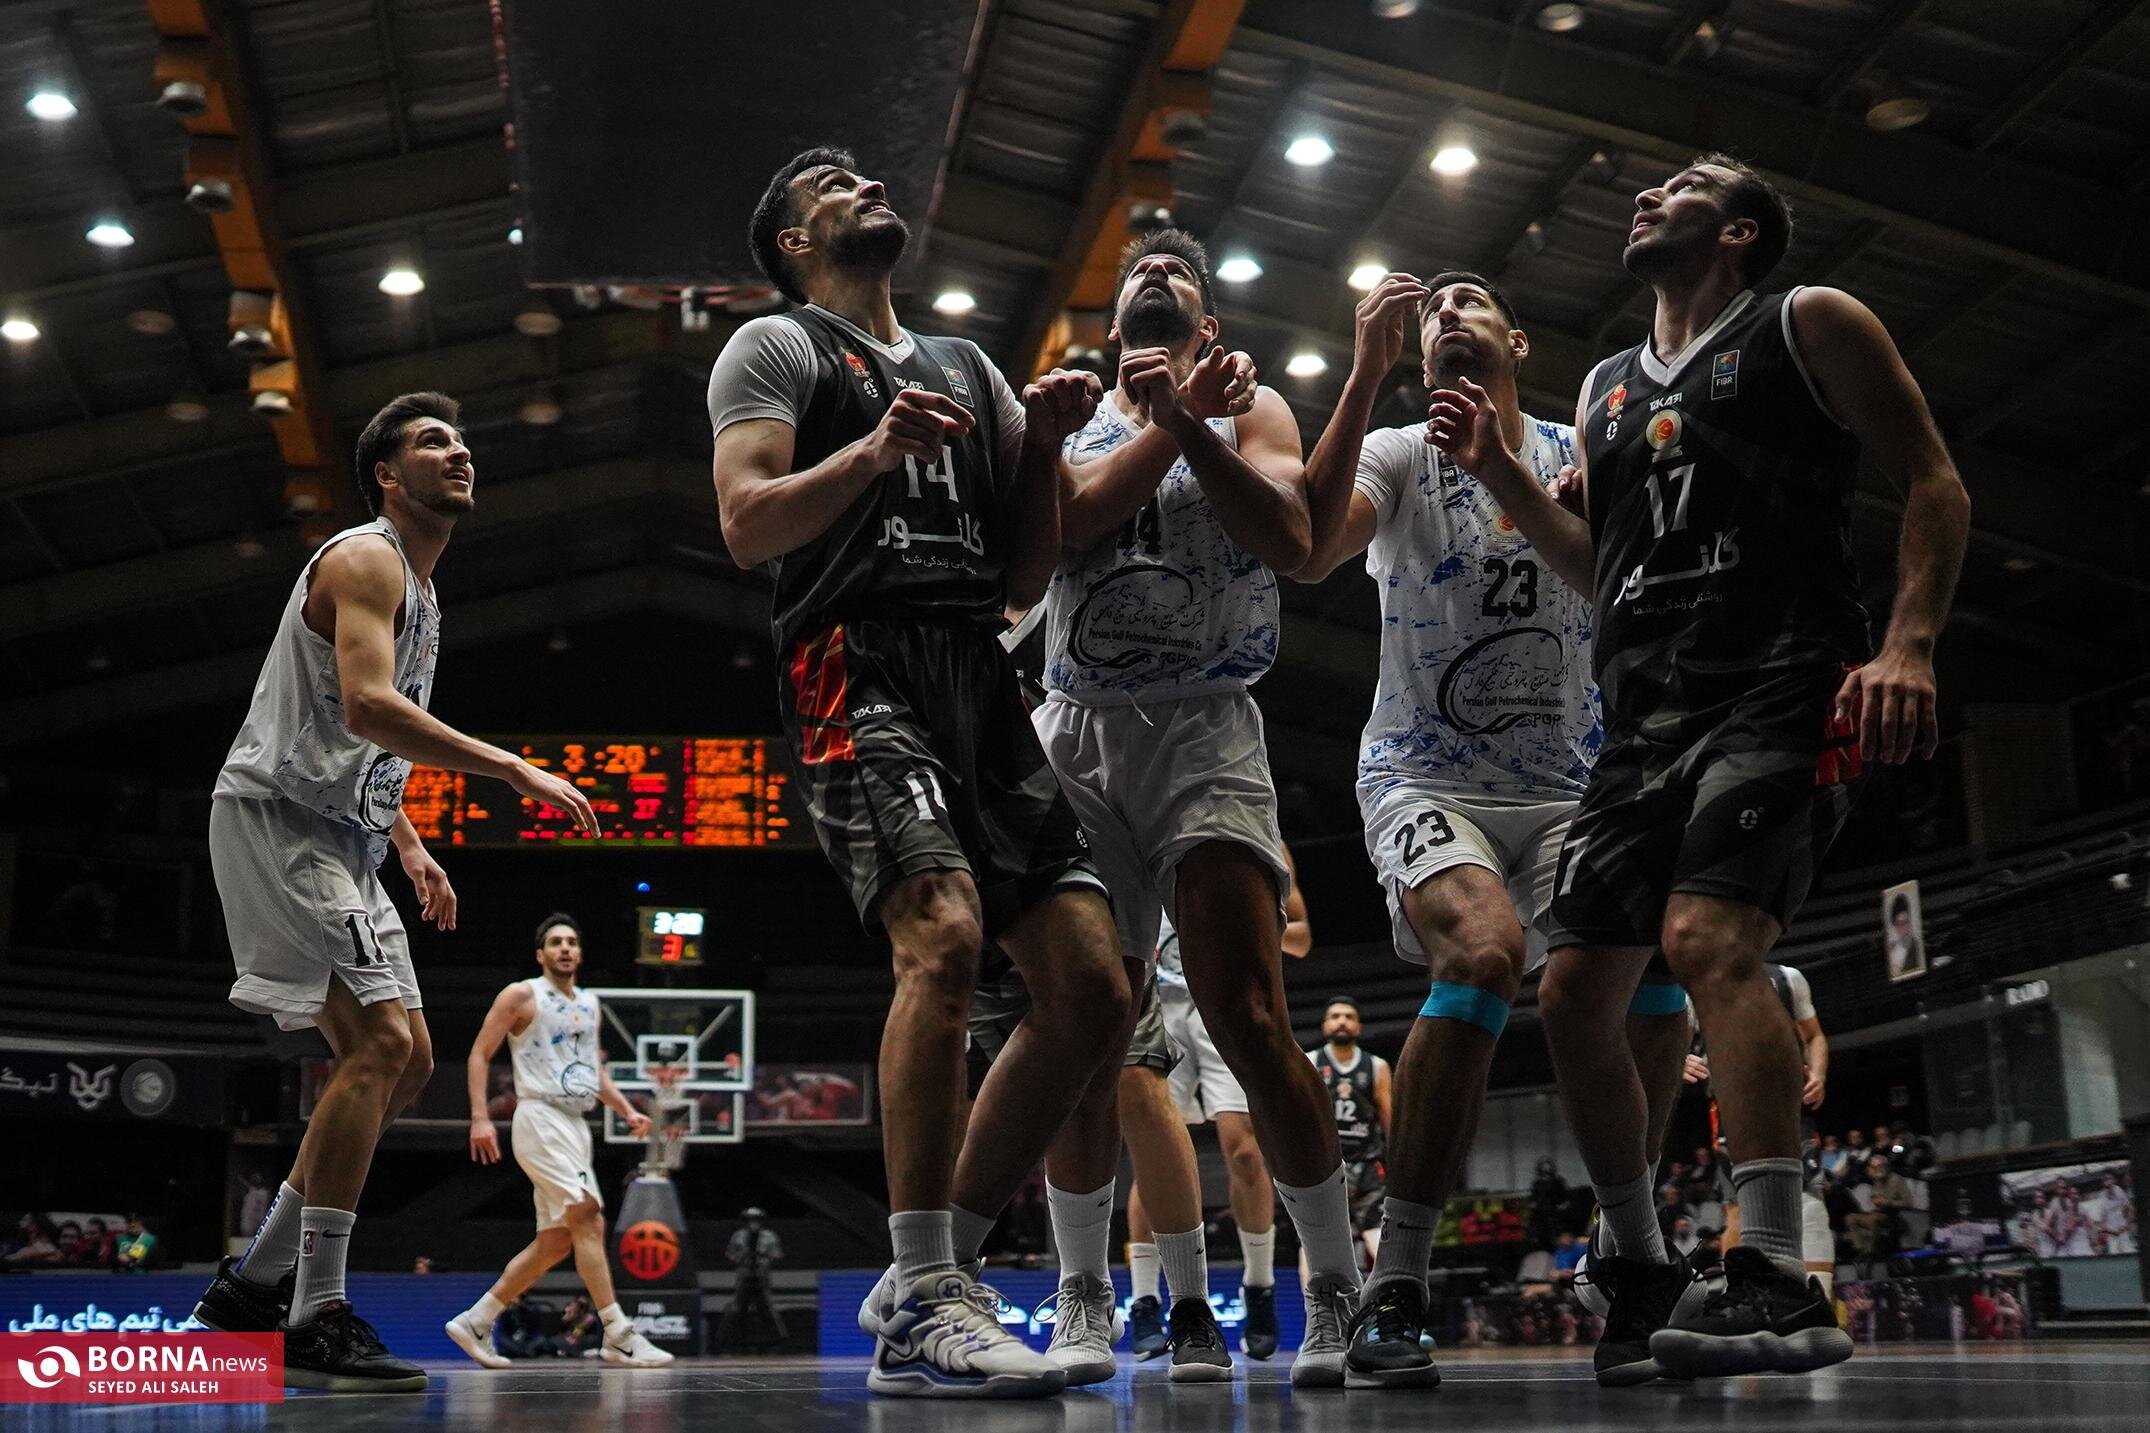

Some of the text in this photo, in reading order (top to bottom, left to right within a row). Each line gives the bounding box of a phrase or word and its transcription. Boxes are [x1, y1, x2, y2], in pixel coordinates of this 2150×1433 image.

[1716, 376, 1733, 386] FIBA
[905, 444, 959, 503] 14
[1644, 463, 1696, 539] 17
[1482, 558, 1539, 618] 23
[563, 744, 646, 774] 3:20
[1394, 810, 1456, 867] 23
[1335, 1099, 1357, 1122] 12
[9, 1303, 59, 1337] ملی
